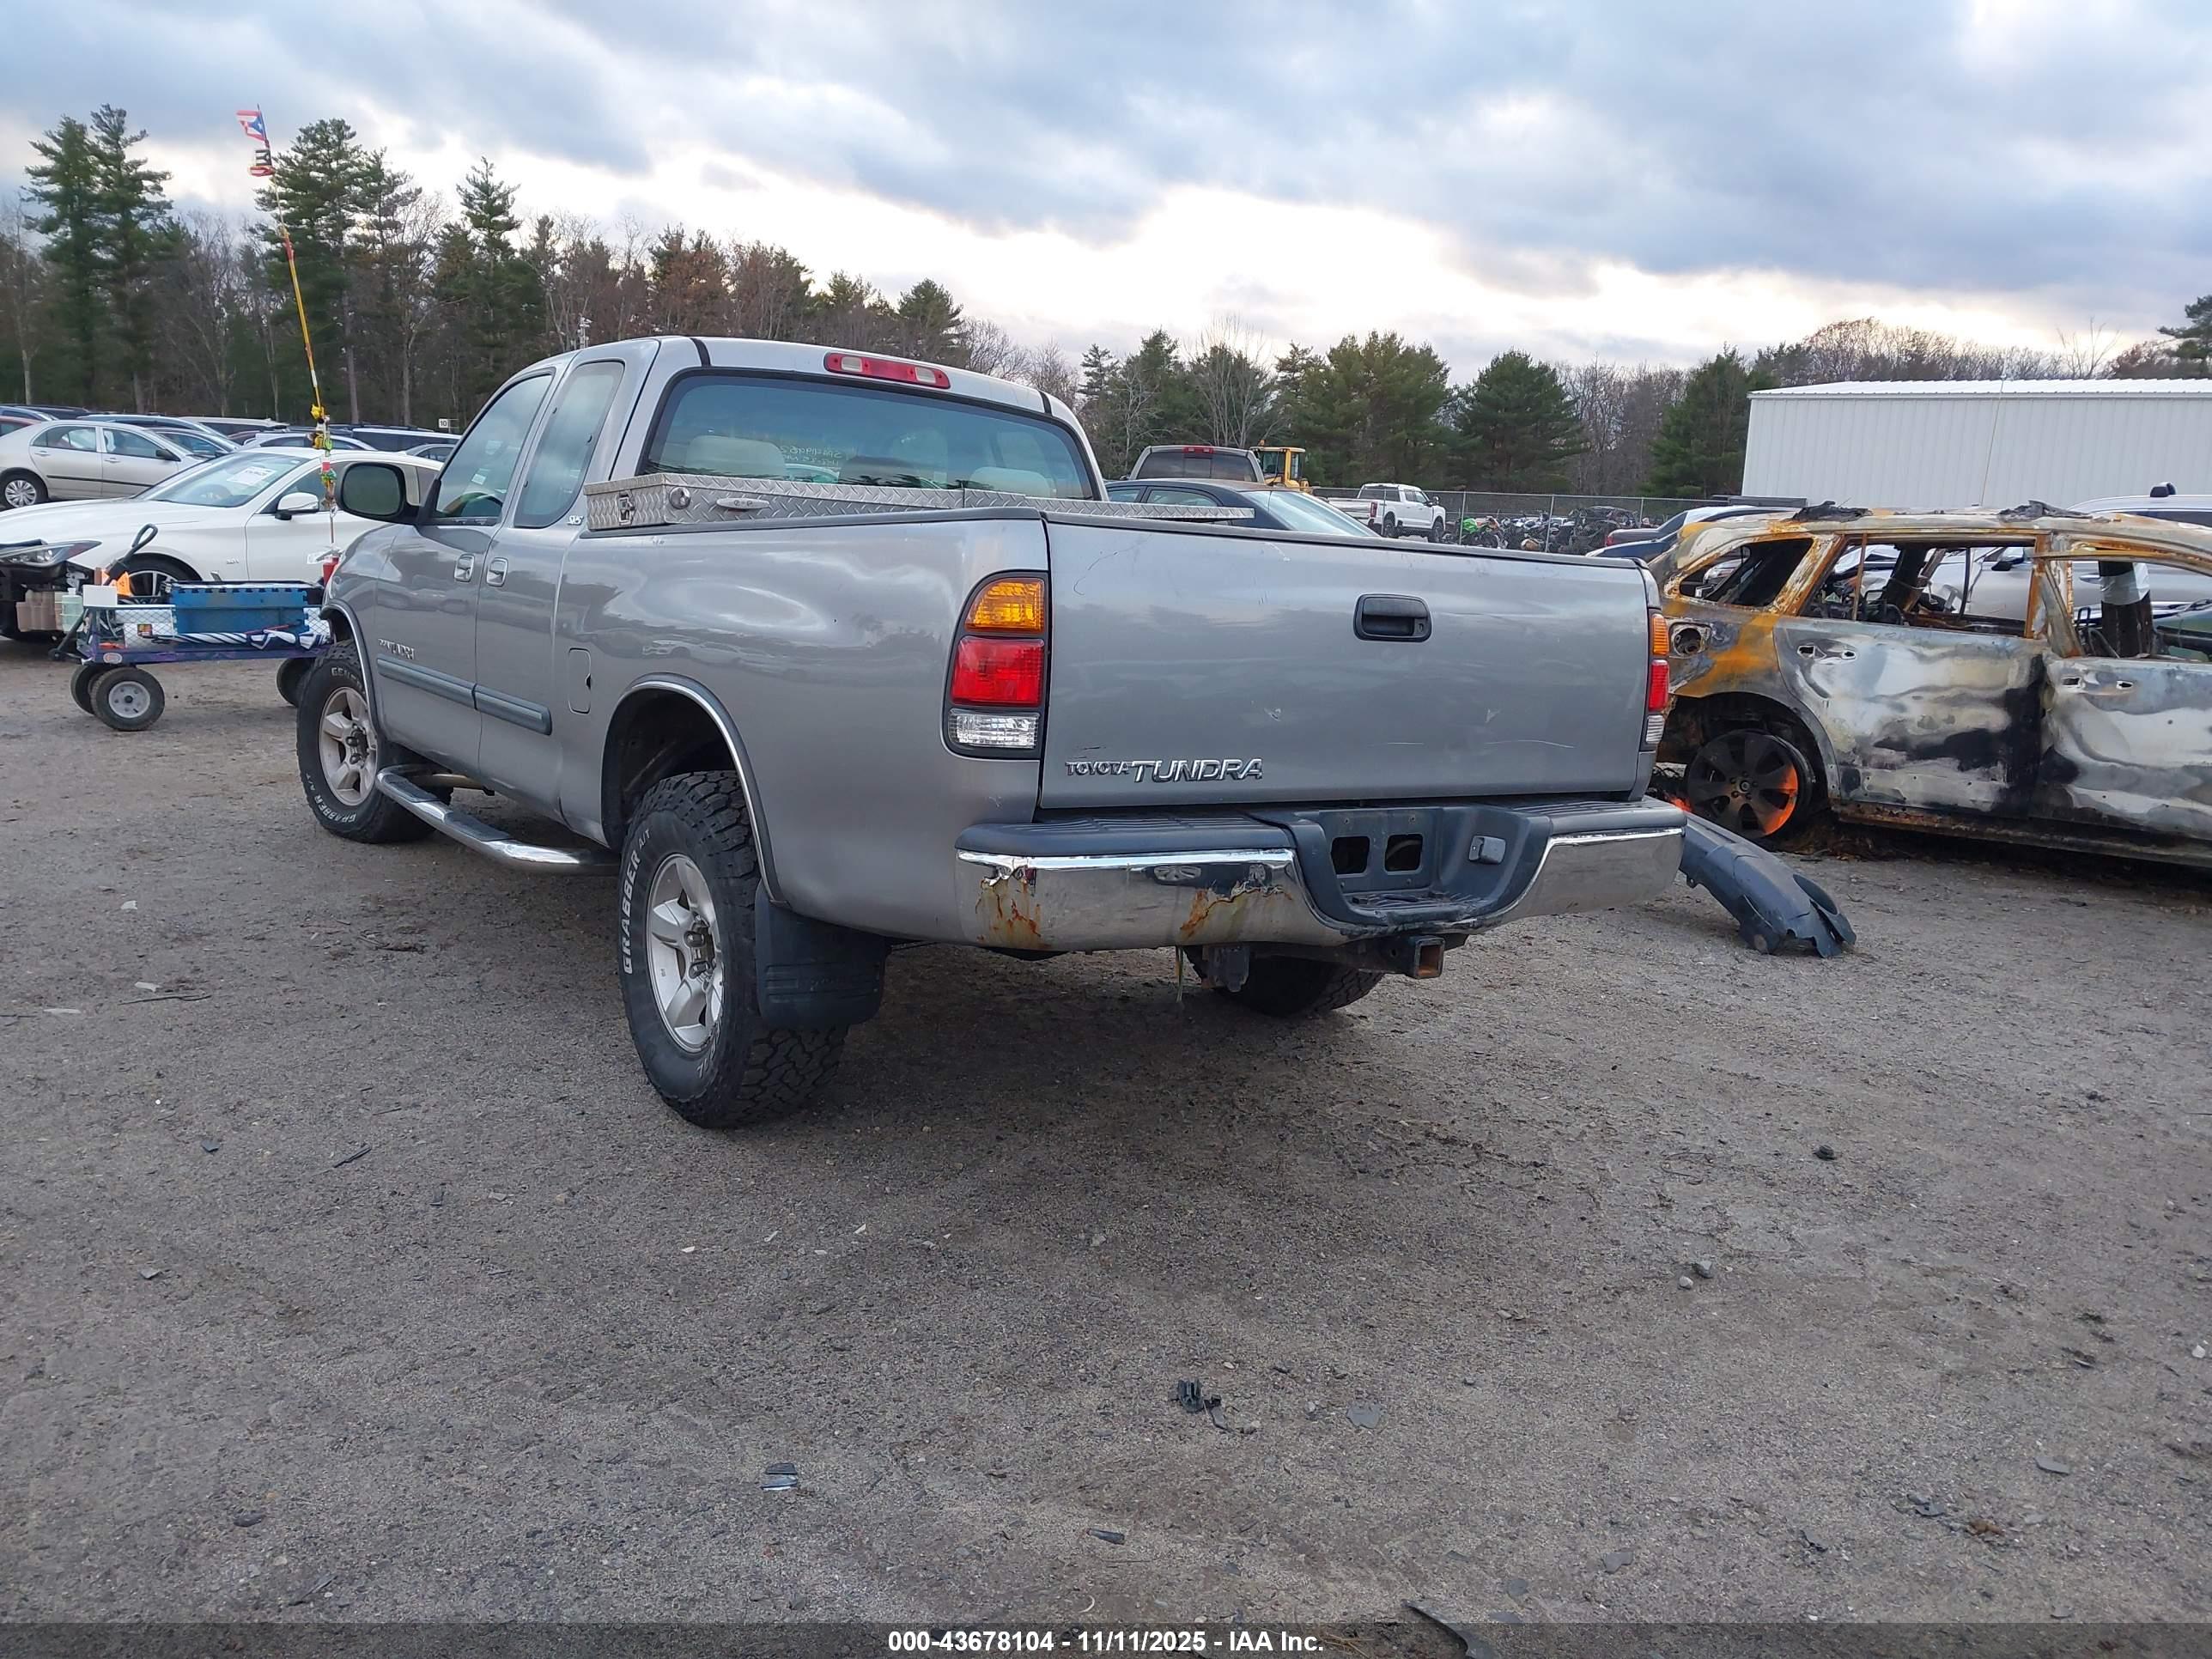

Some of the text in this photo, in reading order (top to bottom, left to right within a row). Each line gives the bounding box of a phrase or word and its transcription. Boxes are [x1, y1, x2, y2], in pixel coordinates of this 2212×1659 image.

[1065, 758, 1263, 782] TOYOTA TUNDRA
[314, 793, 357, 823] GRABBER
[621, 828, 651, 975] GRABBER A/T
